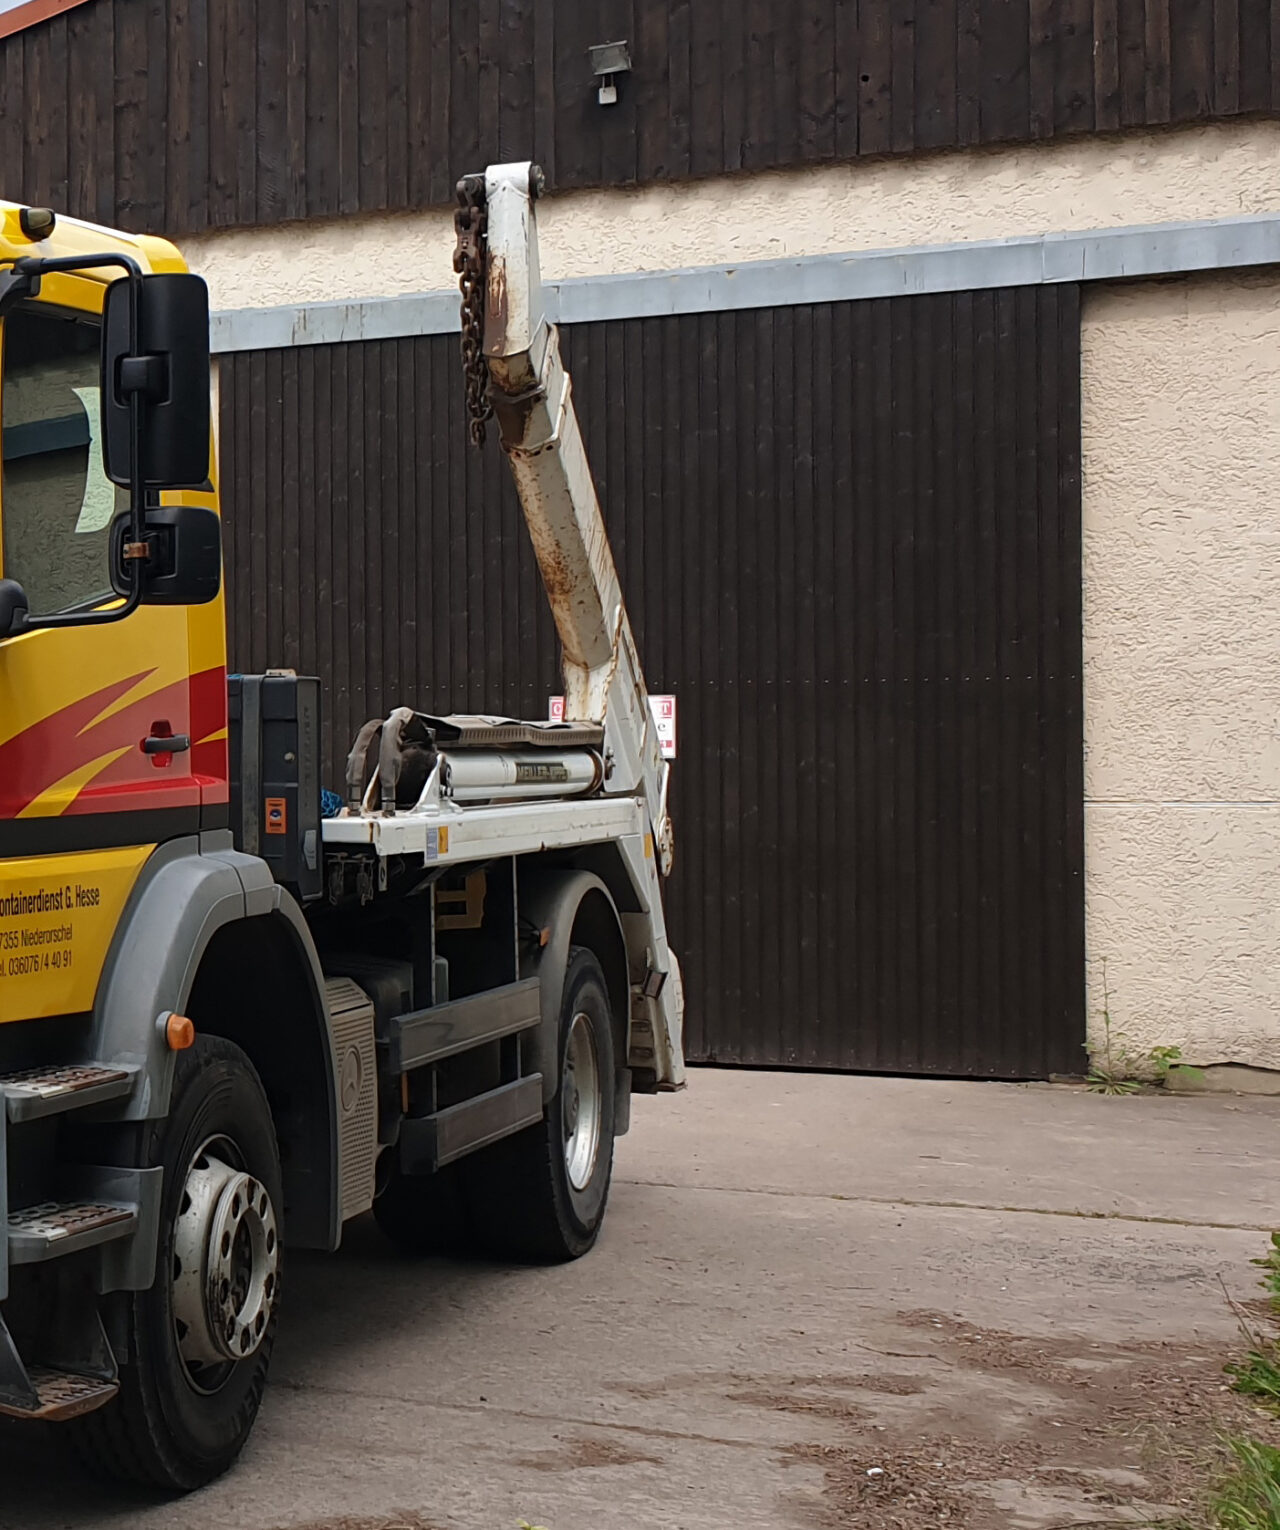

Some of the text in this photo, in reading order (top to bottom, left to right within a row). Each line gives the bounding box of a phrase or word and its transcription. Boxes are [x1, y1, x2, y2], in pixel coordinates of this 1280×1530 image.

[0, 884, 100, 917] ontainerdienst G. Hesse
[0, 923, 73, 950] 7355 Niederorschel
